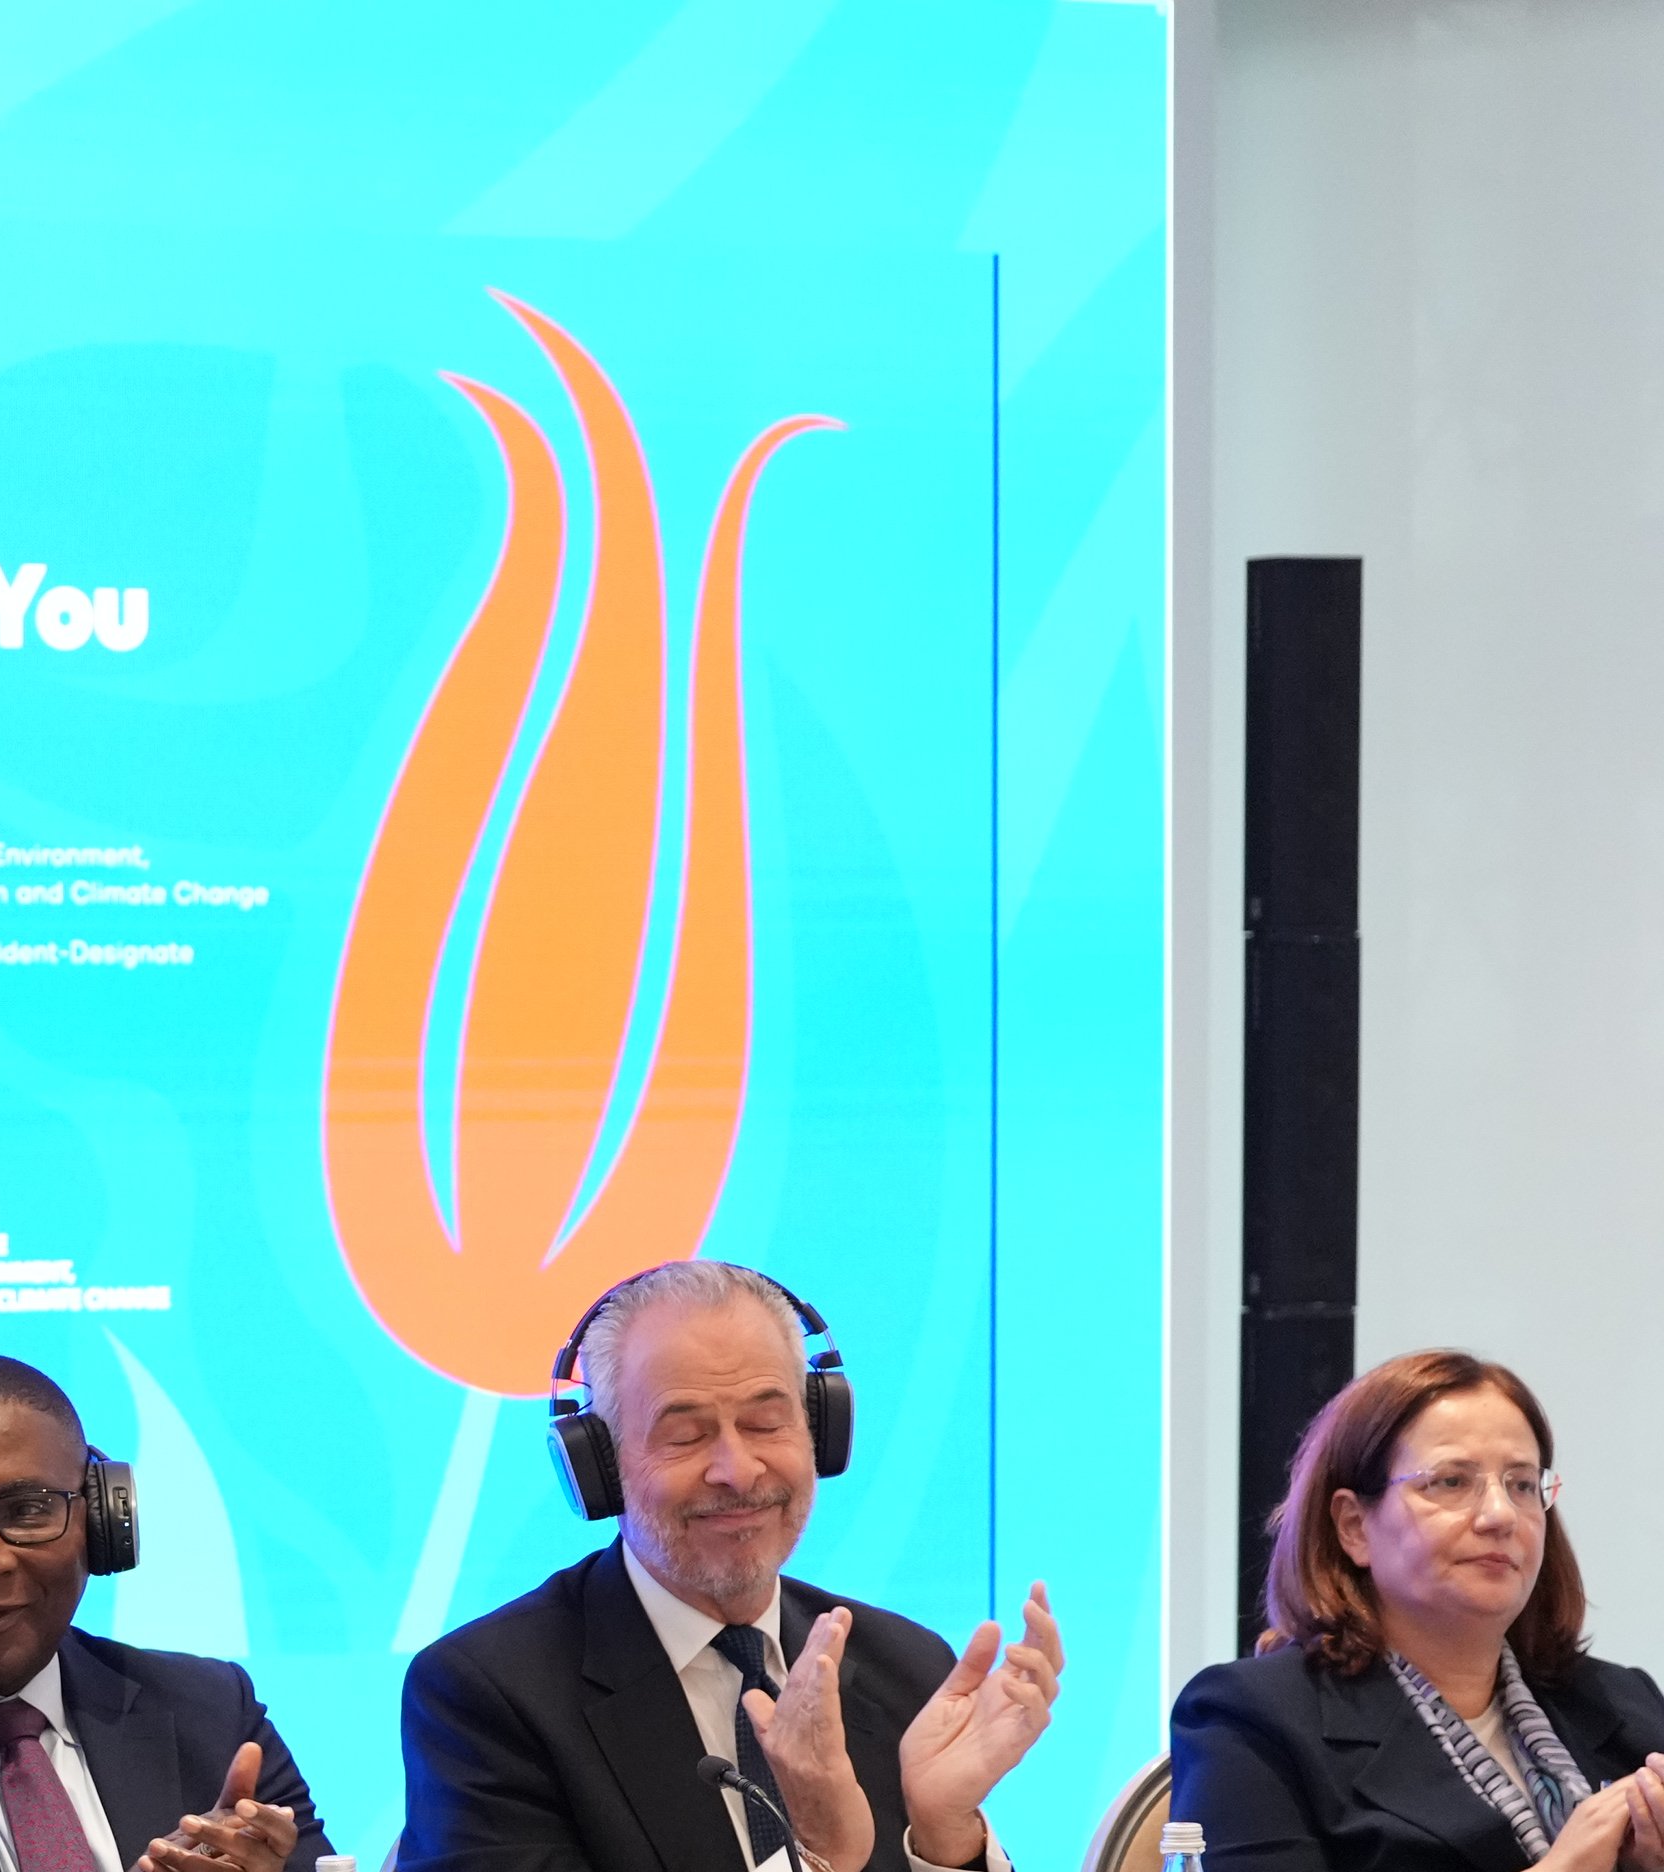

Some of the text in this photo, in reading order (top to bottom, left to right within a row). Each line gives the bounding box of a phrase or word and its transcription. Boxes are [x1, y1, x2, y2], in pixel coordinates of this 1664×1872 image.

[15, 881, 64, 905] and
[70, 879, 167, 905] Climate
[173, 879, 270, 910] Change
